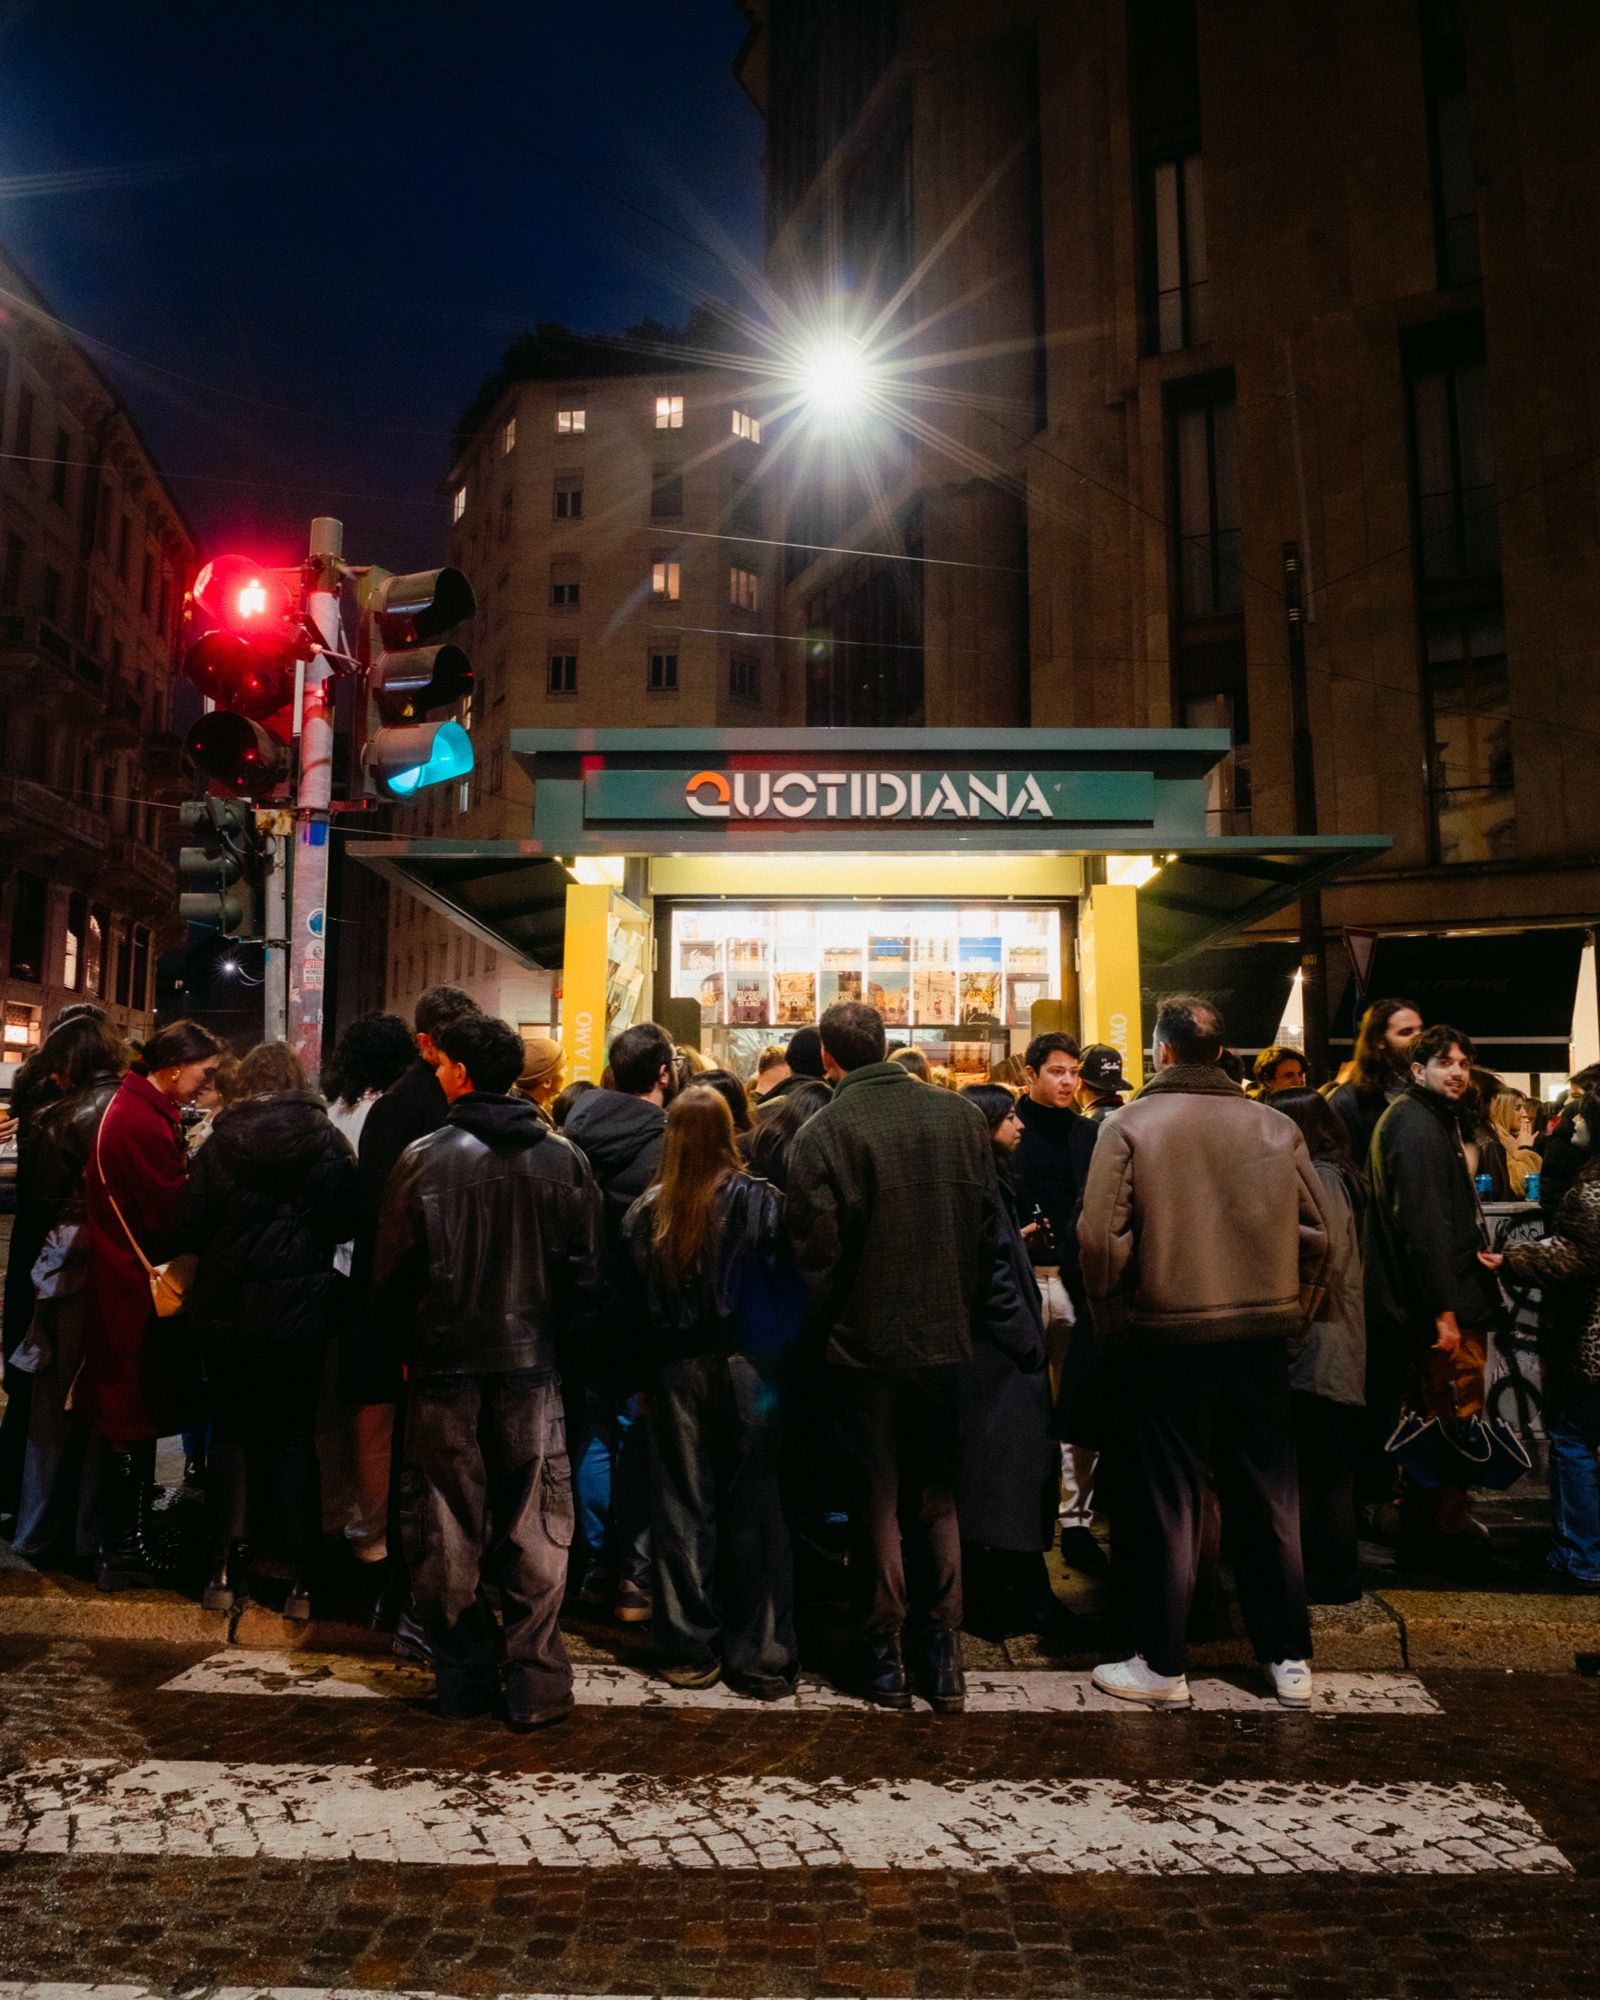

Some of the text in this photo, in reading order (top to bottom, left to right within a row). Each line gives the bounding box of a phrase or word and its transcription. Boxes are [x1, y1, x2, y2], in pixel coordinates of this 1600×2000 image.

[685, 771, 1054, 818] QUOTIDIANA
[572, 1012, 593, 1083] TI AMO
